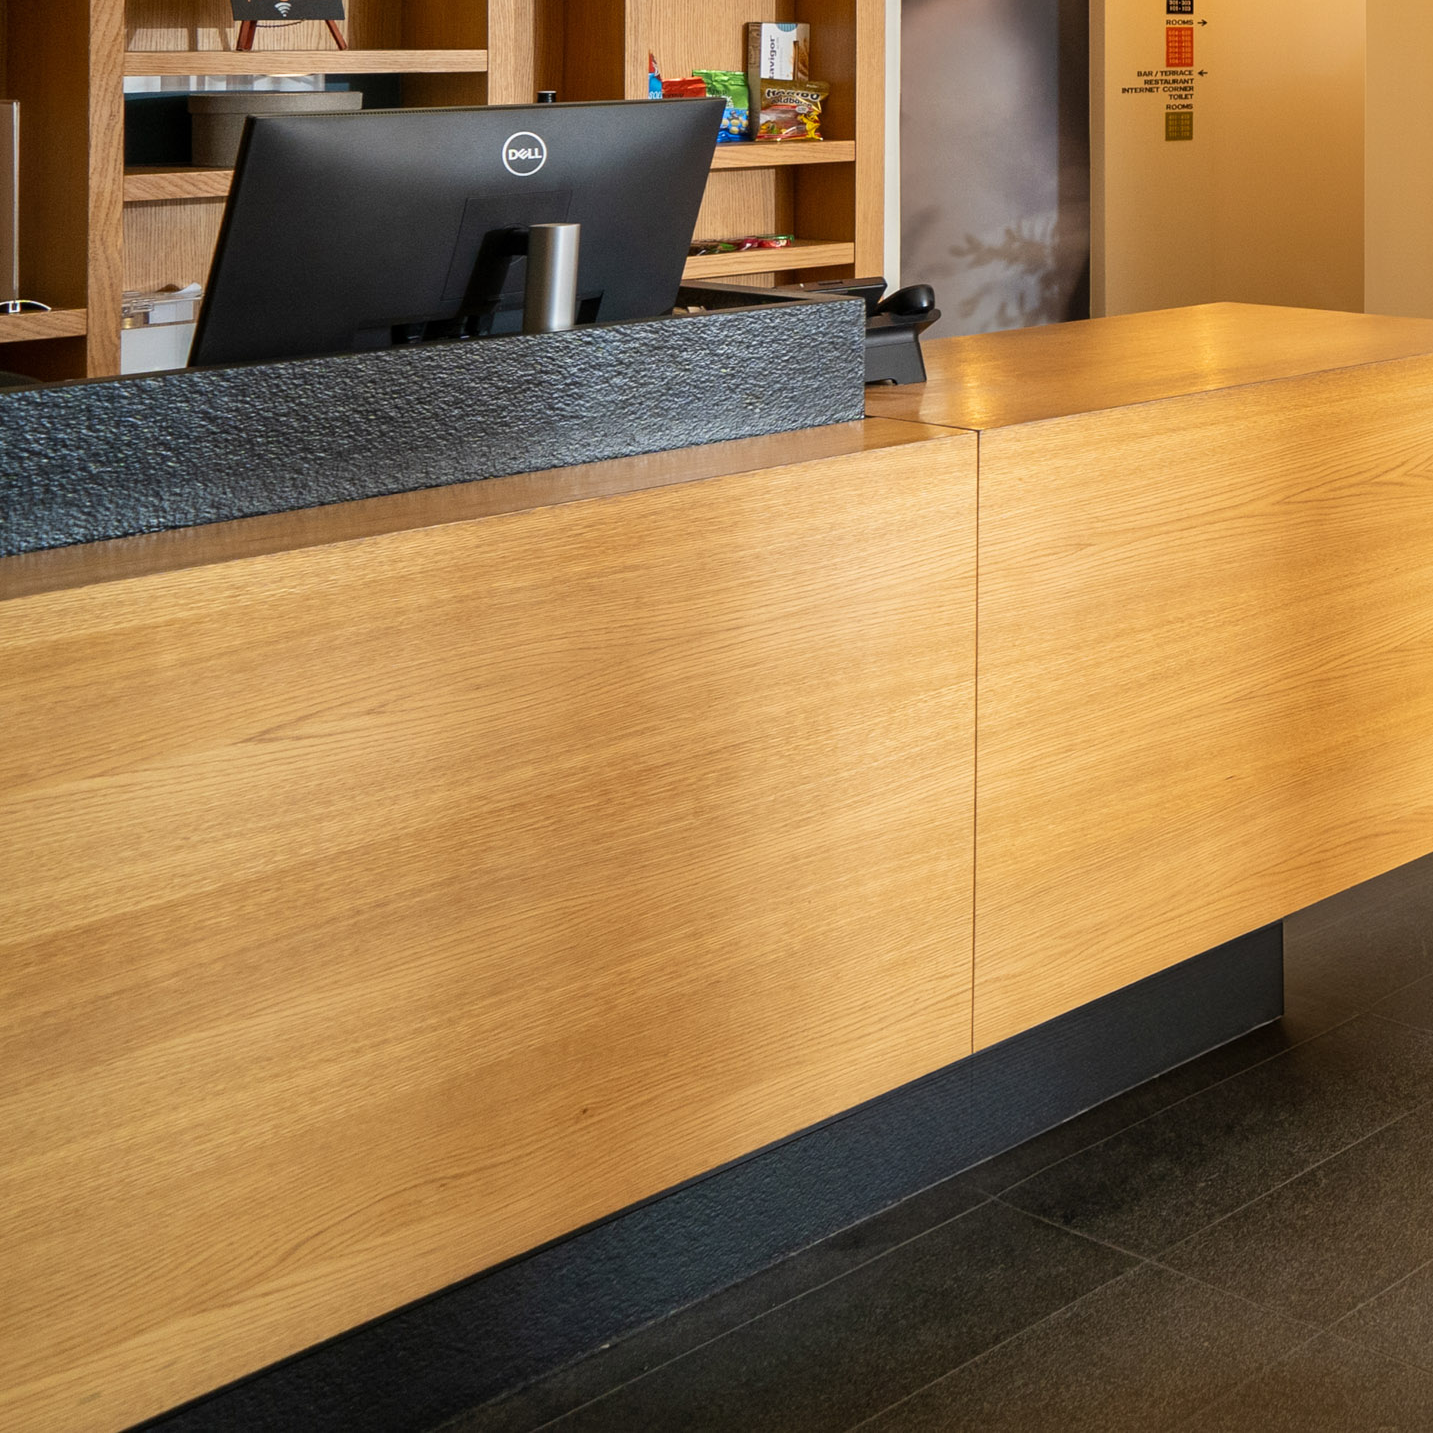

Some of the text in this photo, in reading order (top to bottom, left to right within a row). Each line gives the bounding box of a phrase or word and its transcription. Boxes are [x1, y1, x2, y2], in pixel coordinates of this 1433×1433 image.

[1160, 69, 1194, 77] TERRACE
[1121, 86, 1160, 94] INTERNET
[508, 147, 543, 161] DELL
